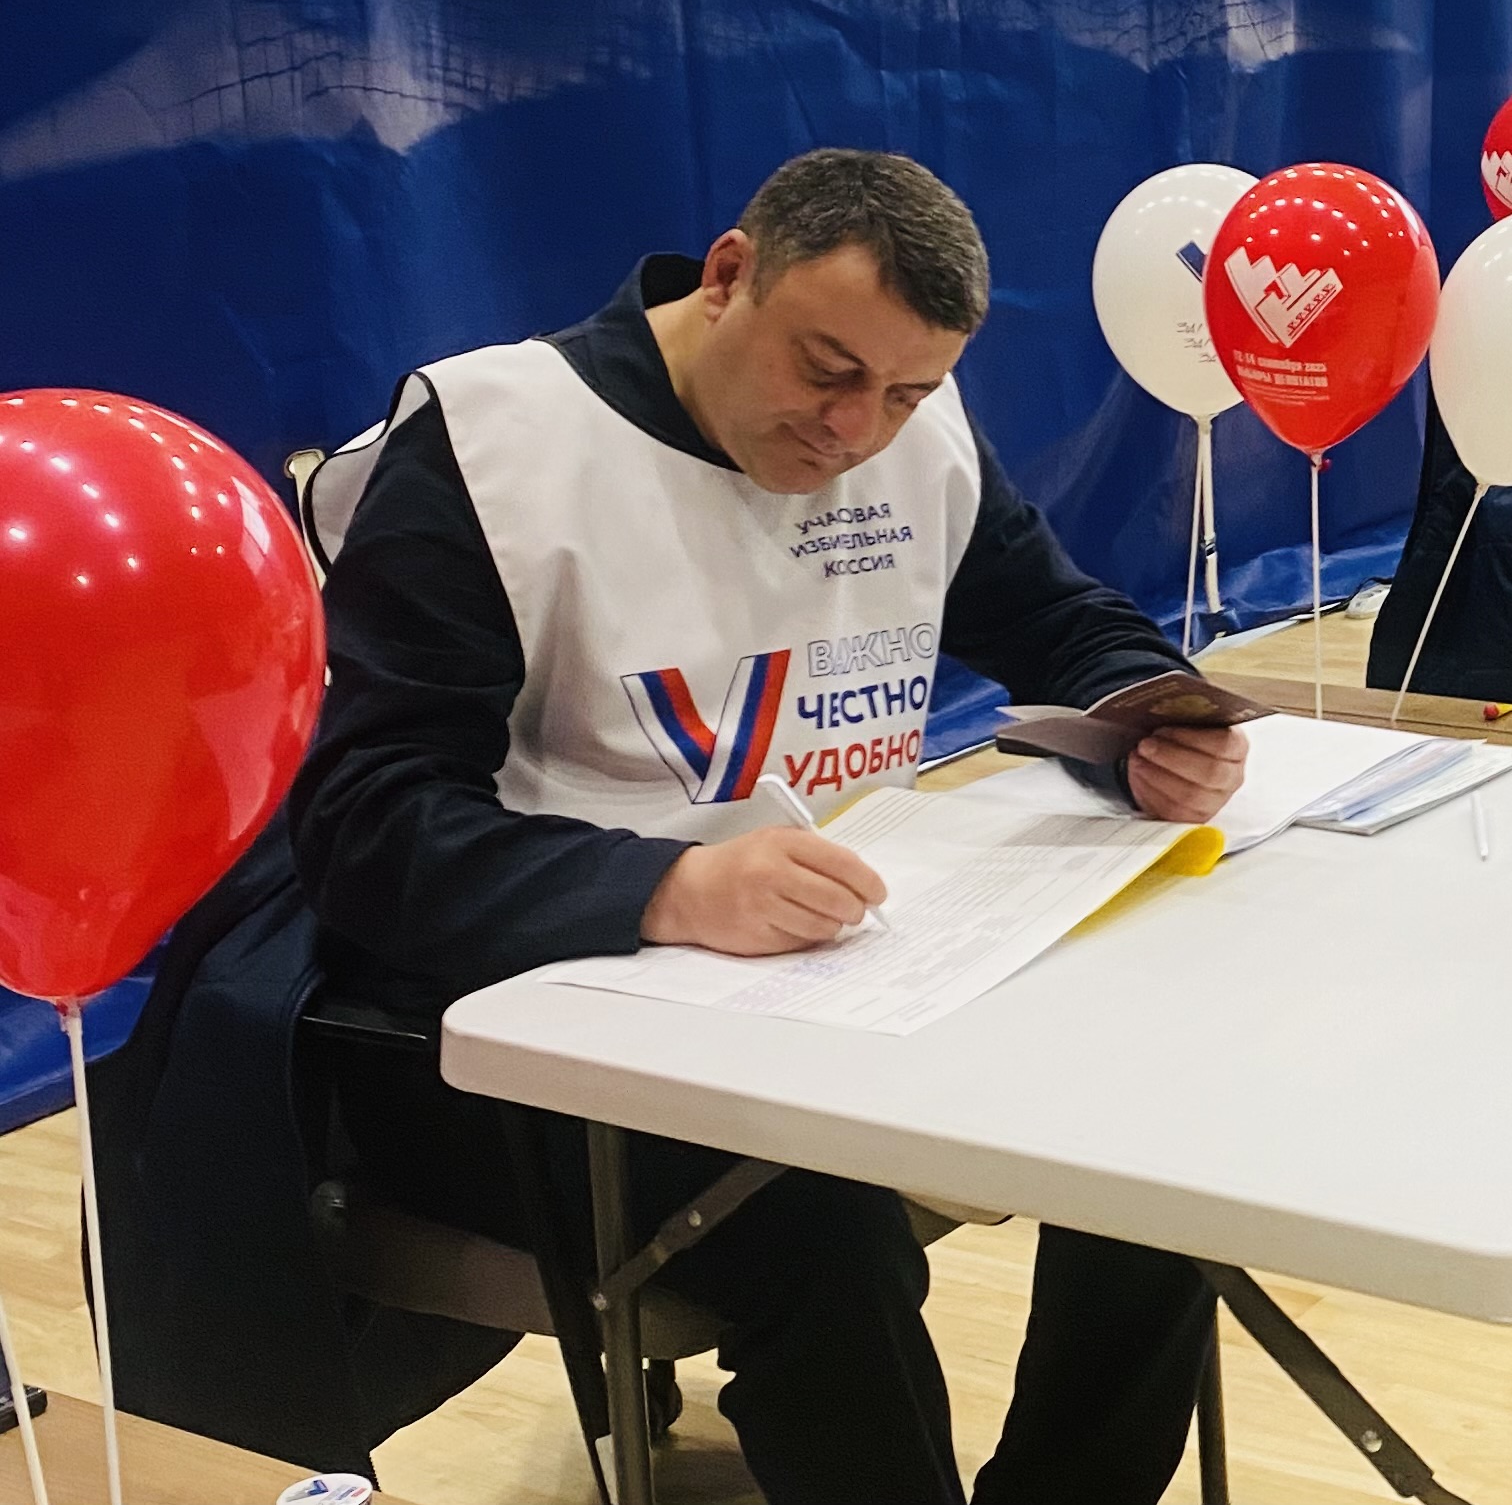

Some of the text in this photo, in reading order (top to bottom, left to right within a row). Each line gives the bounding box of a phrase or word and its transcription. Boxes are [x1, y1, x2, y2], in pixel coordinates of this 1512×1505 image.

[807, 622, 936, 678] ВАЖНО
[796, 675, 928, 730] ЧЕСТНО
[783, 728, 922, 796] УДОБНО
